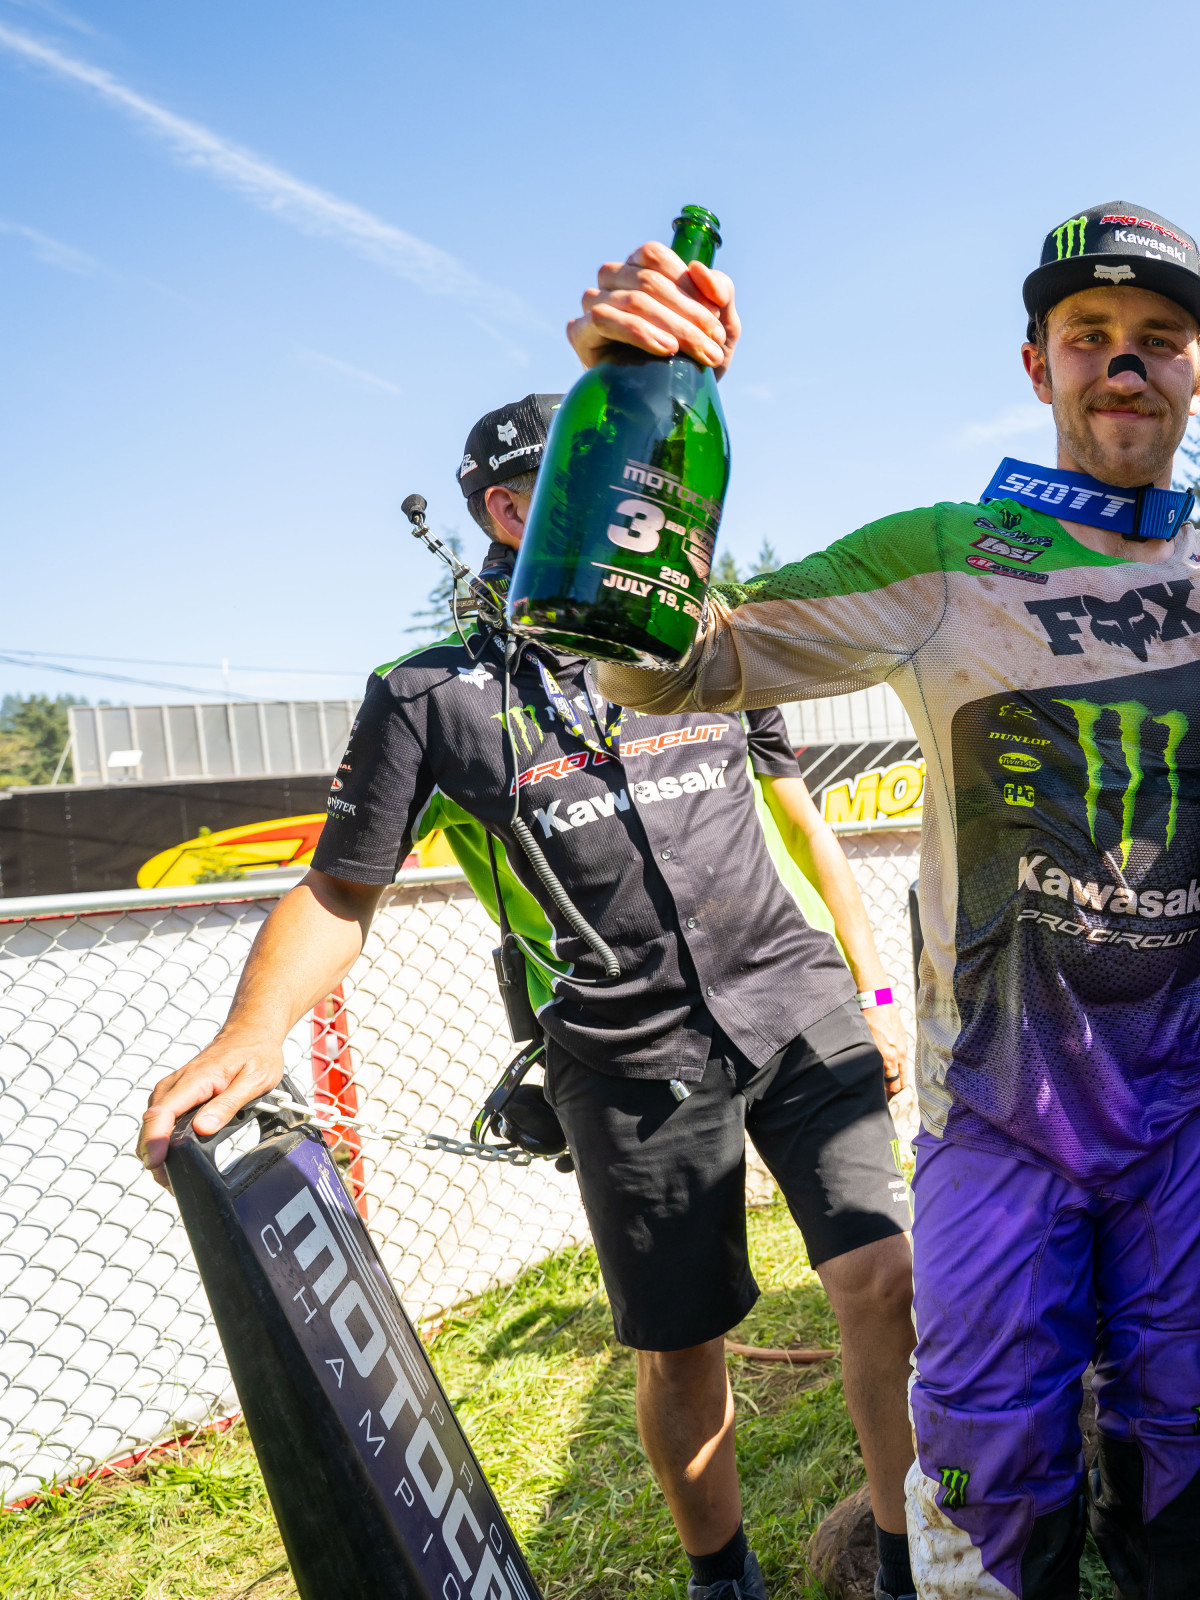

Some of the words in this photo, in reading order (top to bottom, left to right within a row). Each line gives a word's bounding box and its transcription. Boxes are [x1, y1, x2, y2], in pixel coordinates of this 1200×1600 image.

[1099, 214, 1139, 226] PRO
[1138, 218, 1193, 251] CIRCUIT
[1114, 229, 1186, 264] Kawasaki
[499, 444, 543, 464] SCOTT
[998, 472, 1136, 518] SCOTT
[602, 573, 653, 598] JULY
[656, 589, 681, 612] 19,
[659, 565, 690, 589] 250
[988, 731, 1051, 747] DUNLOP
[509, 750, 590, 797] PRO
[592, 723, 730, 768] CIRCUIT
[327, 796, 357, 816] ONSTER
[533, 759, 729, 839] Kawasaki
[823, 758, 927, 823] MO
[1004, 783, 1035, 807] PPG
[1016, 909, 1086, 936] PRO
[1085, 927, 1199, 951] CIRCUIT
[260, 1223, 463, 1600] CHAMPIO
[275, 1184, 518, 1600] MOTOCR
